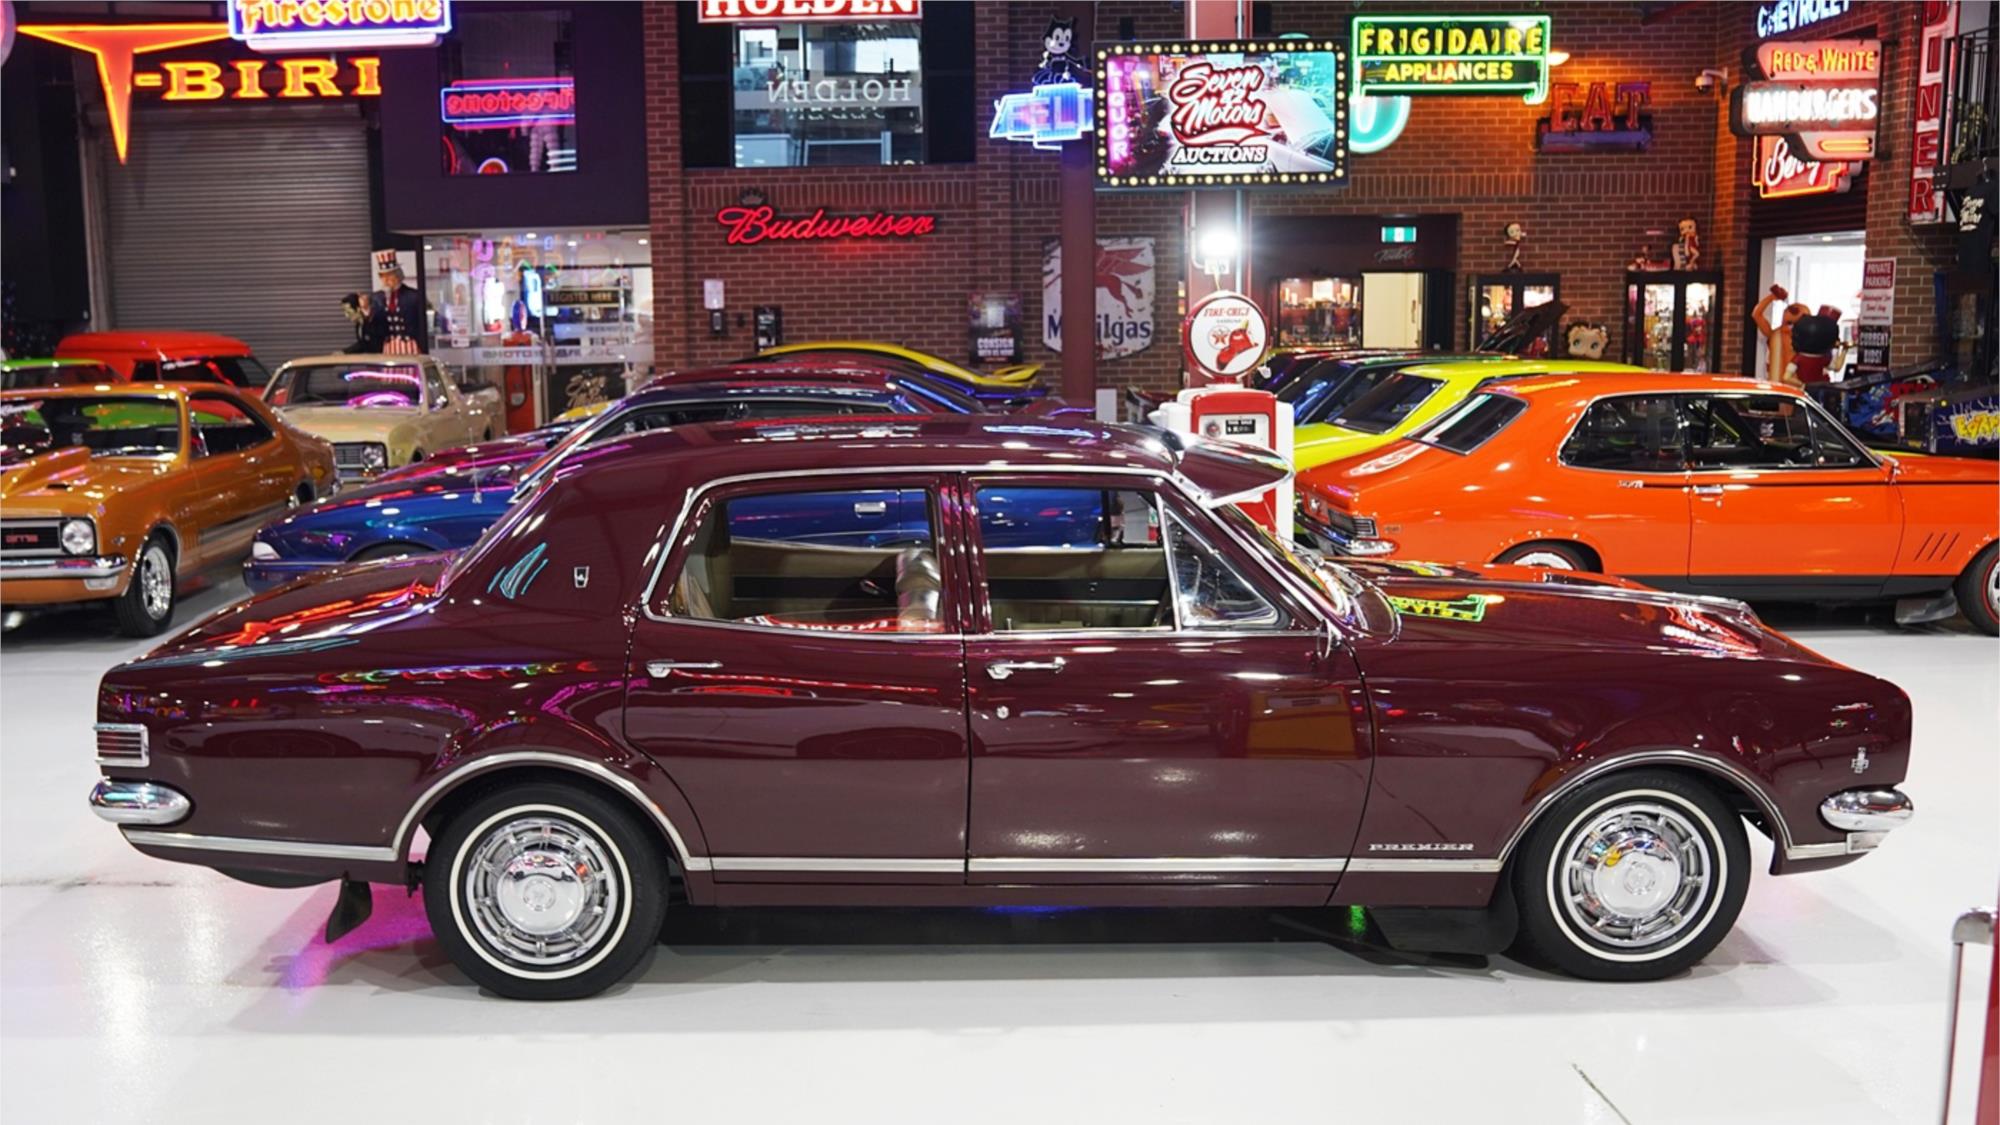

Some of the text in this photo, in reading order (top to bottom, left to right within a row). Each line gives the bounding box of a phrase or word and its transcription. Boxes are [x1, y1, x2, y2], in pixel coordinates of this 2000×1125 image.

[236, 0, 443, 33] Firestone
[704, 0, 917, 17] HOLDEN
[1359, 27, 1542, 54] FRIGIDAIRE
[1385, 62, 1513, 81] APPLIANCES
[1773, 51, 1804, 72] RED
[1822, 48, 1875, 72] WHITE
[1174, 98, 1264, 134] Motors
[1551, 82, 1651, 132] EAT
[1747, 88, 1877, 123] HAMBURGERS
[1911, 0, 1945, 212] DINER
[1172, 147, 1266, 163] AUCTIONS
[717, 206, 934, 244] Budweiser
[1048, 313, 1151, 345] Milgas
[1368, 843, 1474, 851] PREMIER
